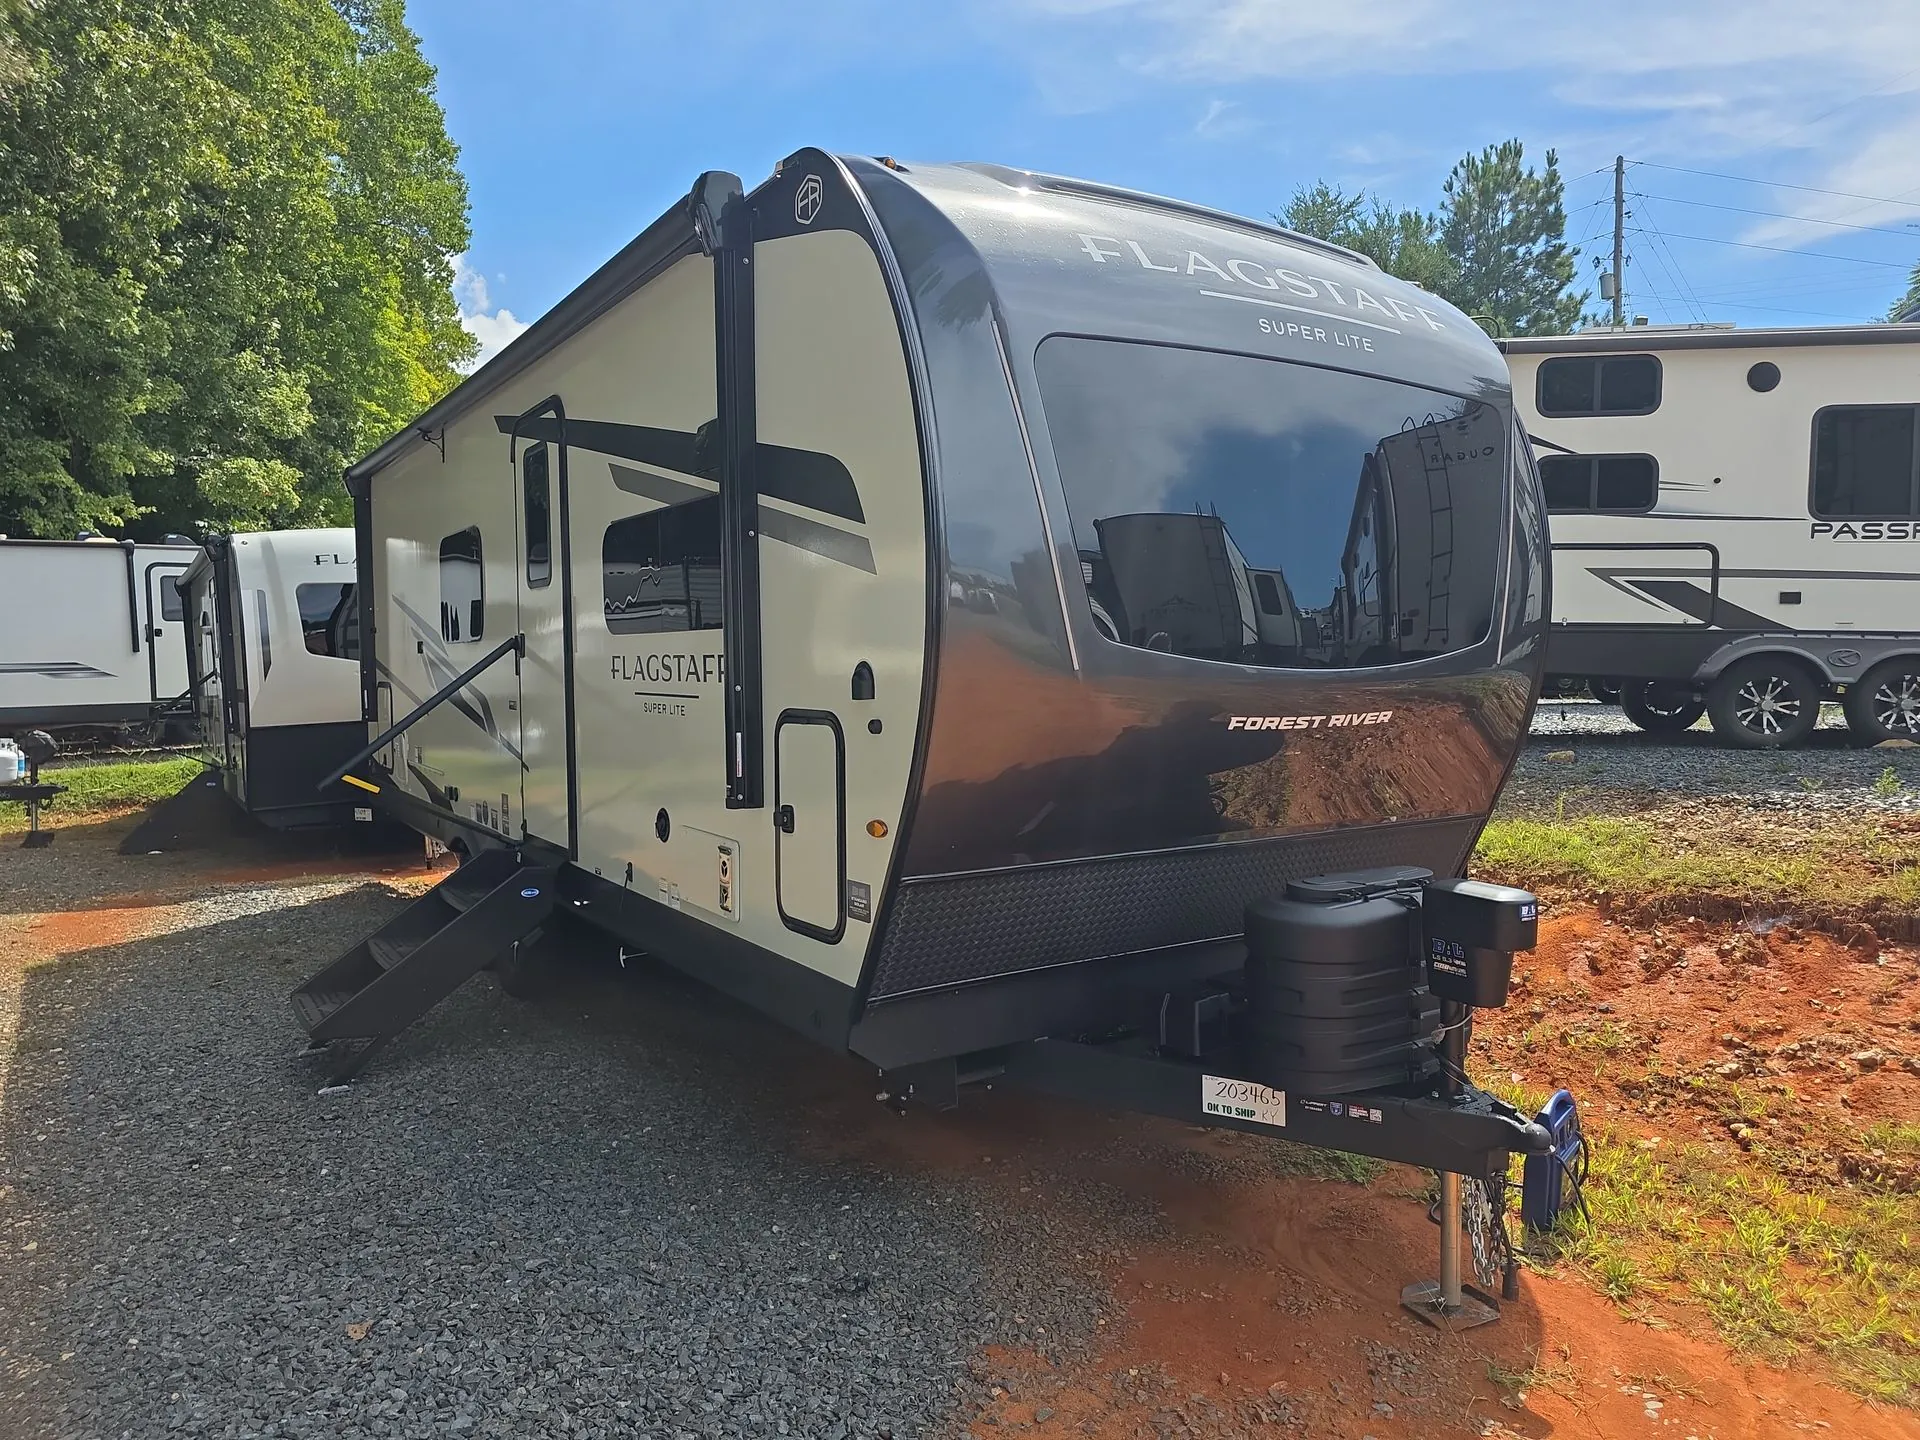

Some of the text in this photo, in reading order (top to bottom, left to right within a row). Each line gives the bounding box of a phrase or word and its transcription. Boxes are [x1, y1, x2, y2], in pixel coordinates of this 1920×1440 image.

[1078, 233, 1447, 332] FLAGSTAFF
[1259, 318, 1375, 353] SUPER LITE
[643, 702, 686, 717] SUPER LITE
[1227, 710, 1393, 731] FOREST RIVER
[1215, 1081, 1281, 1106] 203465
[1207, 1102, 1256, 1119] OK TO SHIP
[1261, 1108, 1279, 1124] KY
